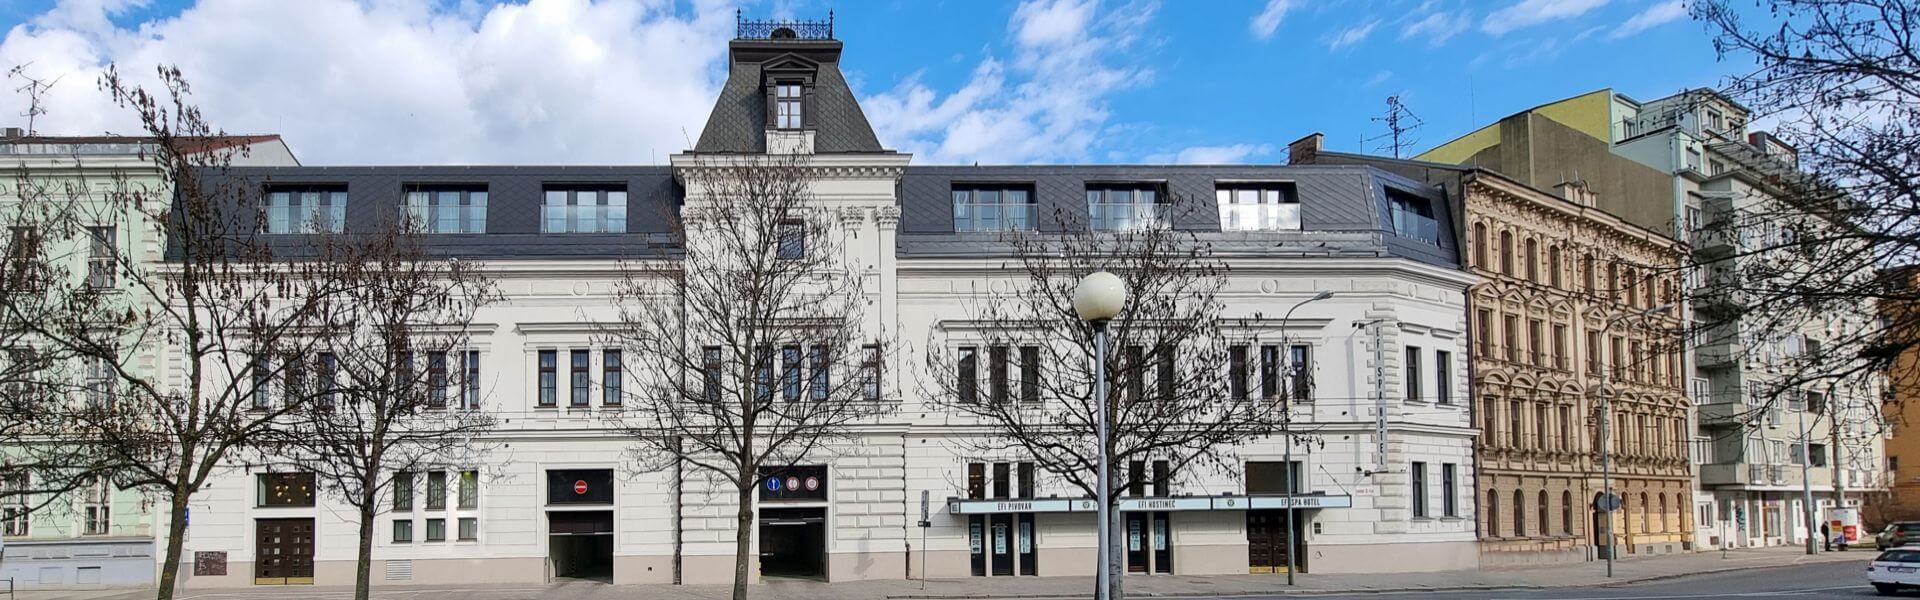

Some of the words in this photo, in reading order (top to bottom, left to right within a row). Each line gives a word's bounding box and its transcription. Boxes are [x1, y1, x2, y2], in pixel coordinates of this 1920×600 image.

[1291, 498, 1302, 506] SPA
[1303, 497, 1321, 506] HOTEL
[998, 503, 1007, 511] EFI
[1009, 502, 1032, 510] PIVOVAR
